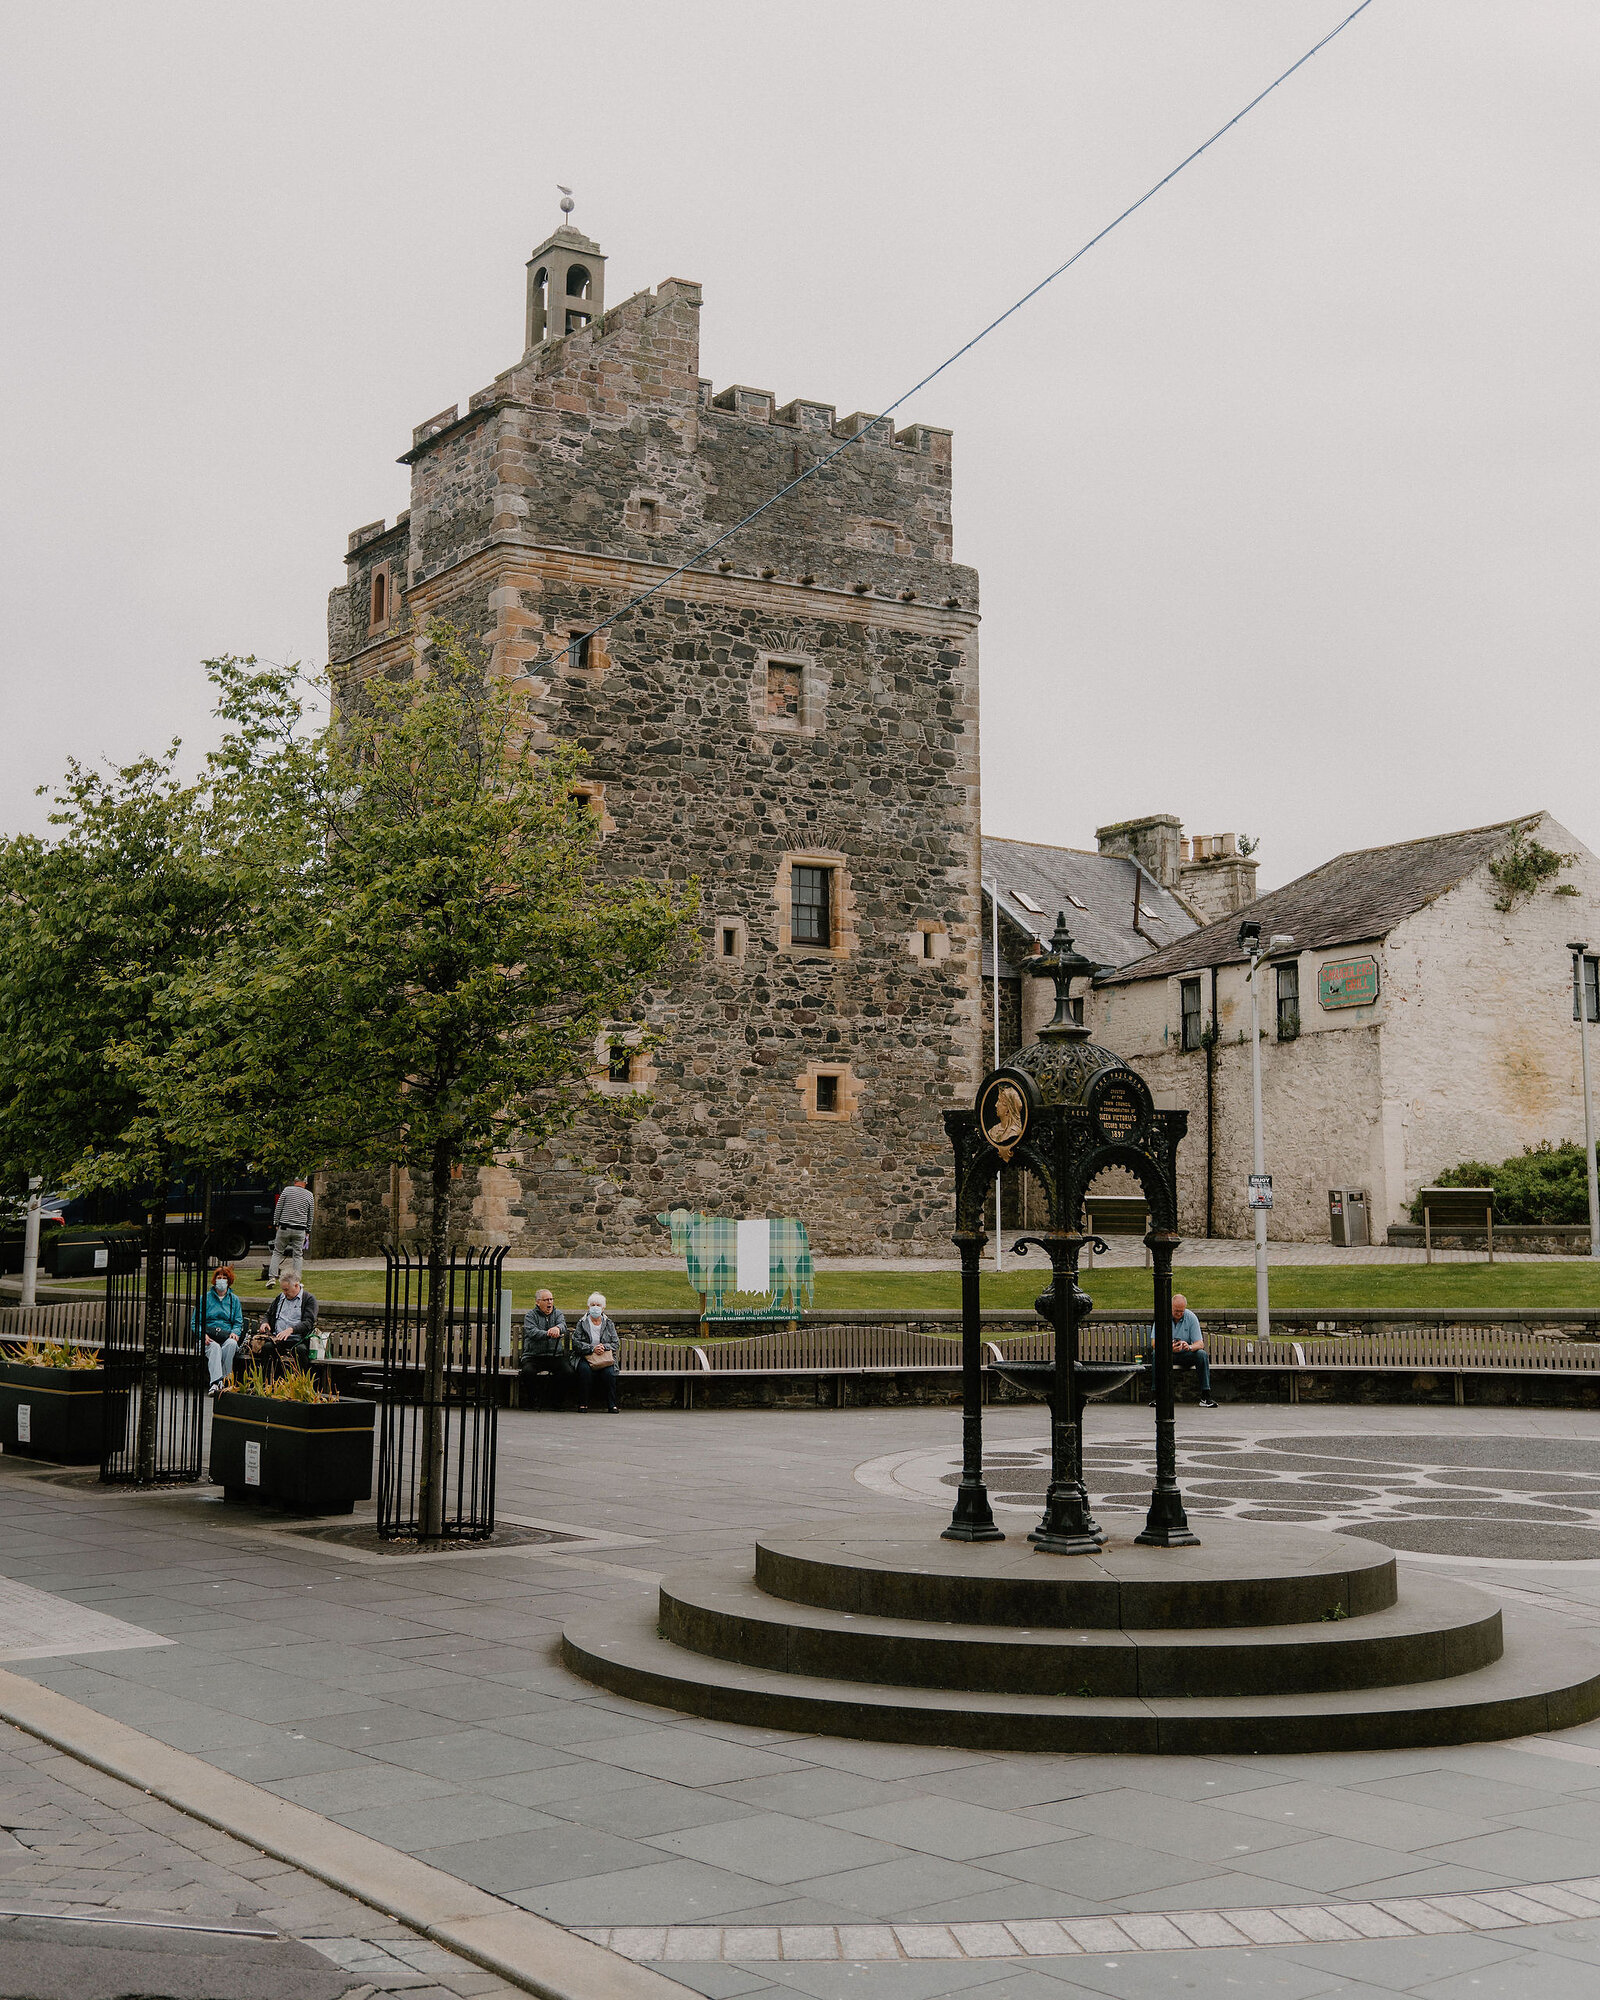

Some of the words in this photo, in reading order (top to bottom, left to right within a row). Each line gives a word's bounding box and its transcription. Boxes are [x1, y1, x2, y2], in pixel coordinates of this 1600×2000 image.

[1345, 977, 1370, 992] GRILL
[1071, 1109, 1089, 1117] KEEP
[1098, 1113, 1111, 1121] QUEEN
[1112, 1114, 1137, 1122] VICTORIA'S
[1111, 1130, 1125, 1138] 1897
